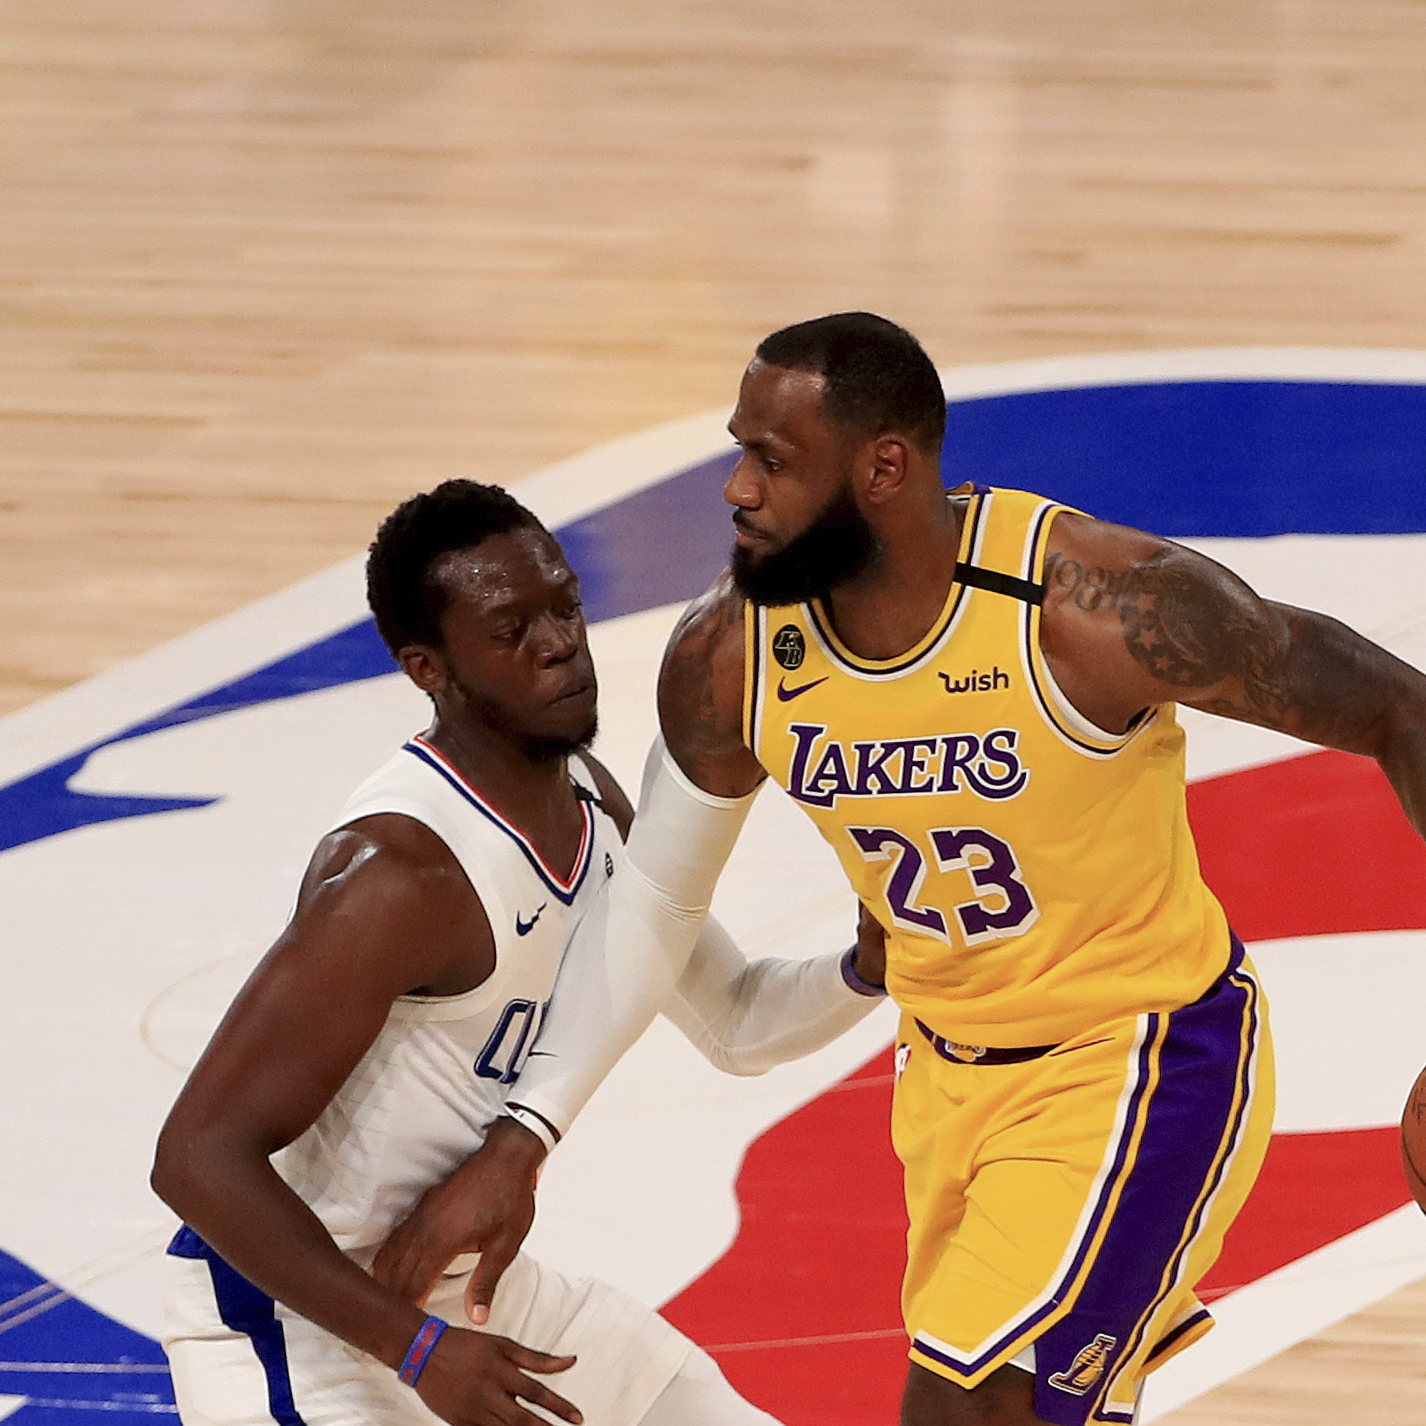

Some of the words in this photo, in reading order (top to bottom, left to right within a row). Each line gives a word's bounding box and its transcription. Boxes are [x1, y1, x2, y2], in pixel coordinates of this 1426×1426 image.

[938, 666, 1010, 693] wish
[786, 721, 1031, 811] LAKERS
[843, 824, 1042, 947] 23
